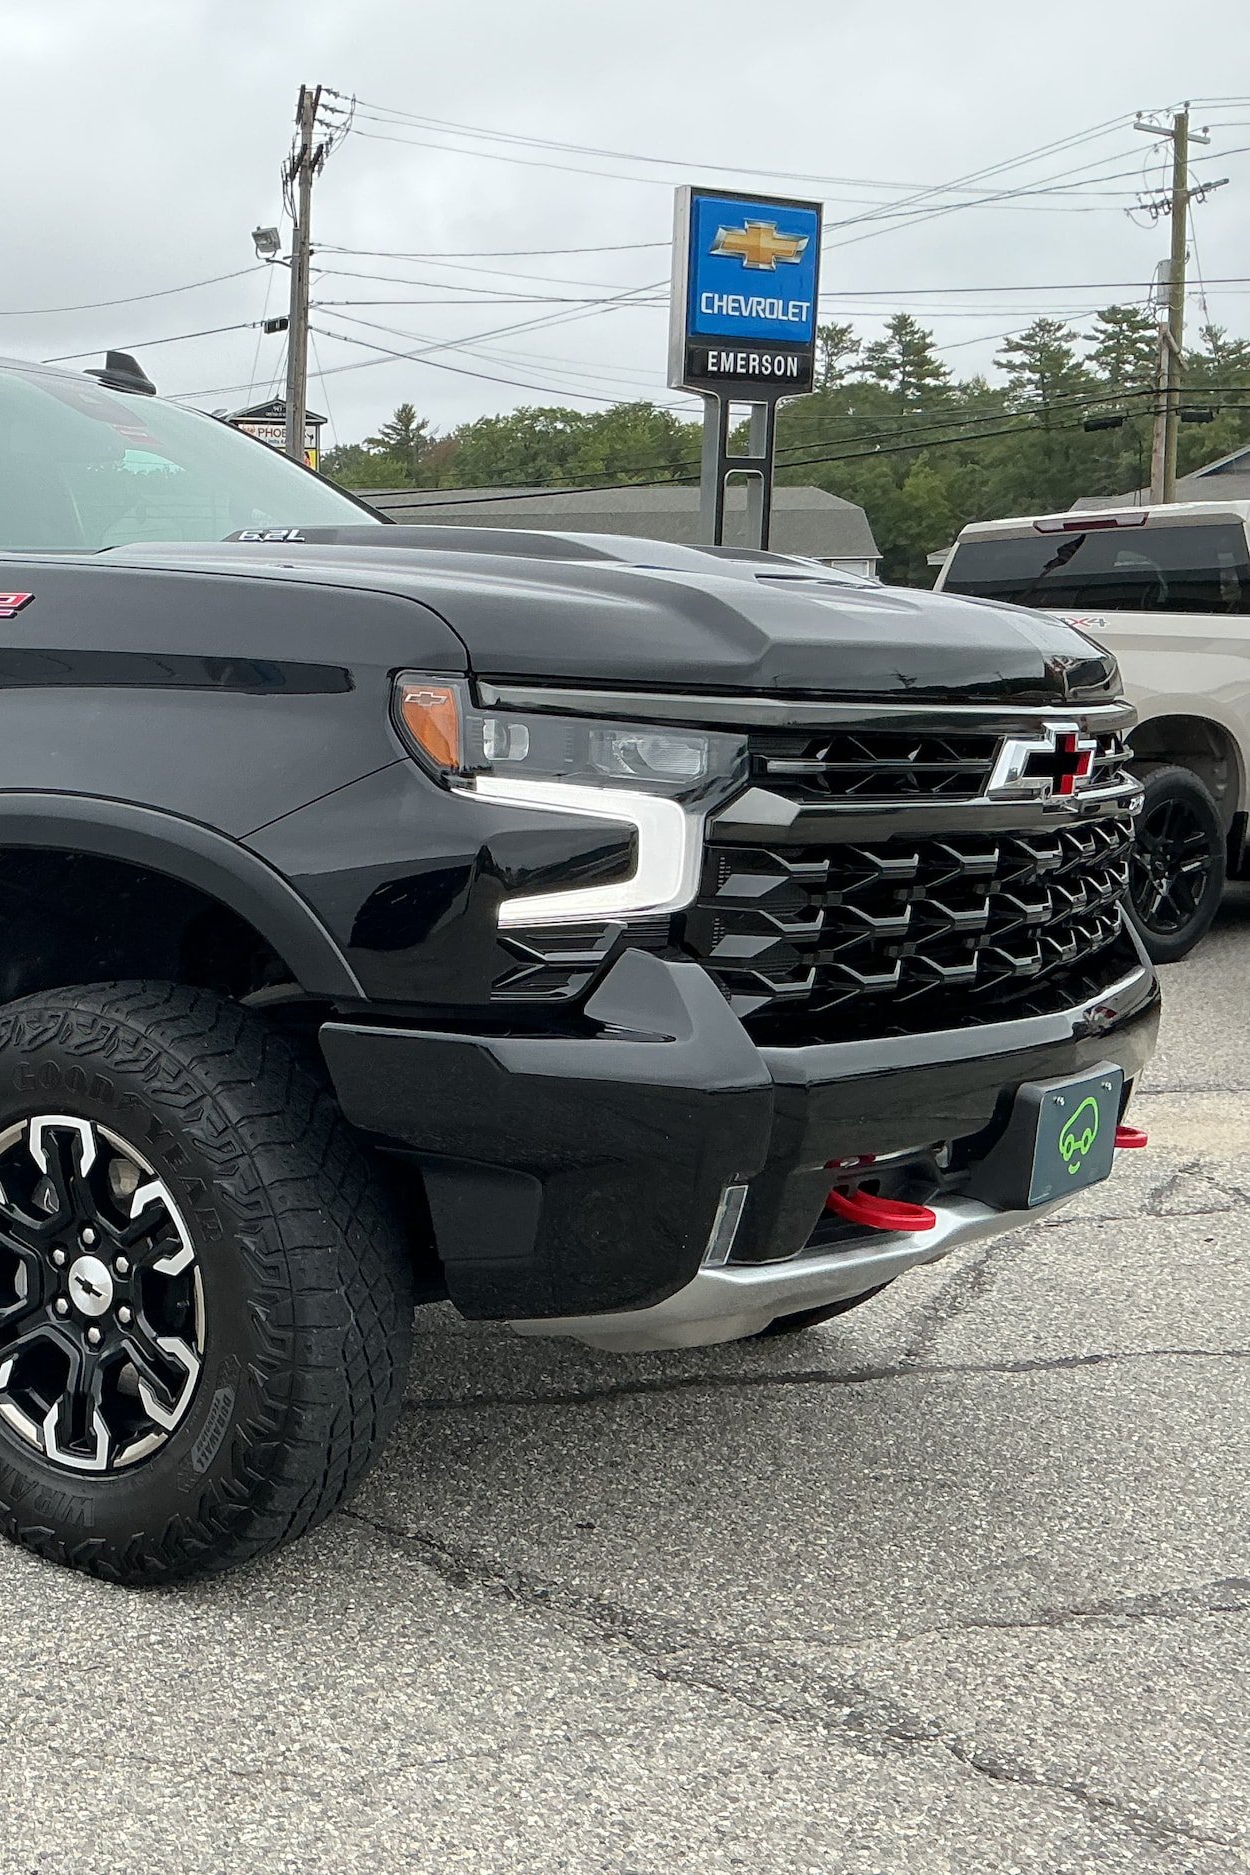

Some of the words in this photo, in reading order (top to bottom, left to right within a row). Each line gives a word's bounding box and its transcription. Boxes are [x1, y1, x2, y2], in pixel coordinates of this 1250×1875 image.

[701, 292, 810, 322] CHEVROLET
[707, 351, 799, 378] EMERSON
[258, 427, 307, 438] PHOE
[196, 1393, 233, 1468] DURAWALL
